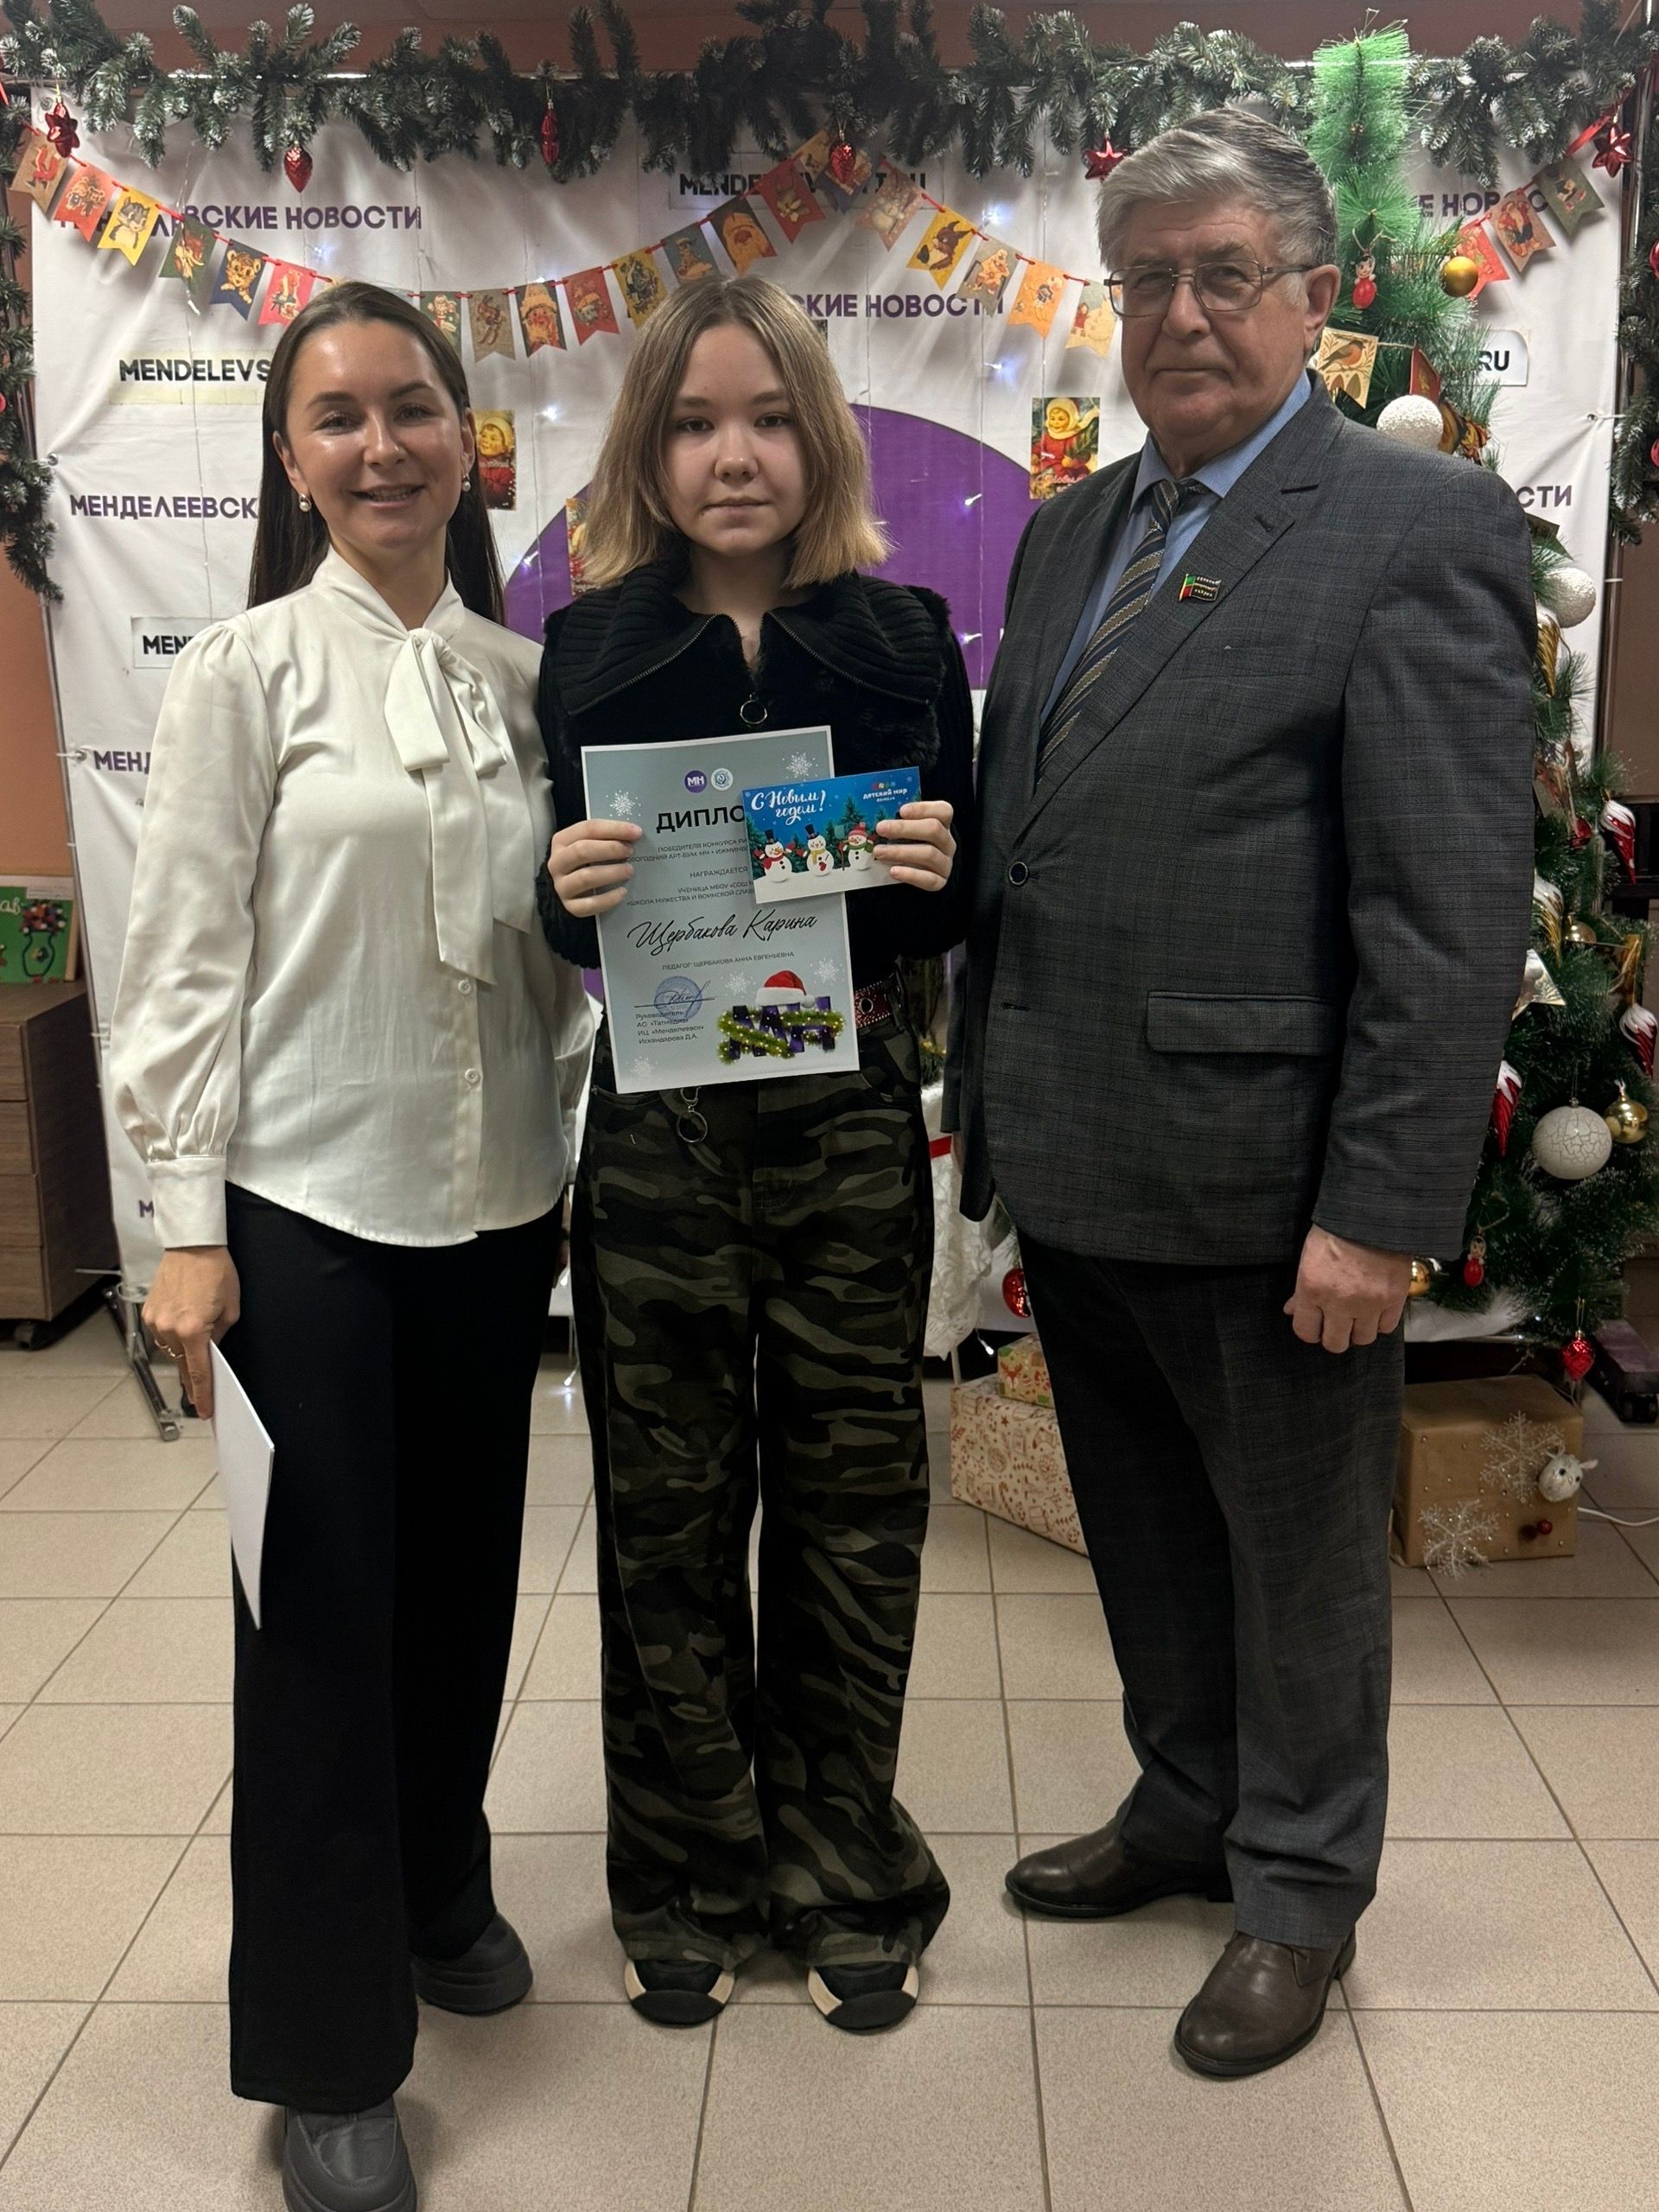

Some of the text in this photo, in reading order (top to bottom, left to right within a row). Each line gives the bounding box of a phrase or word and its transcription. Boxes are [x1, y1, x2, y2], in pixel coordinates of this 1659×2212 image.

[285, 205, 422, 230] НОВОСТИ
[143, 635, 194, 655] MEN
[687, 776, 705, 787] МН
[766, 788, 819, 808] Новым
[626, 854, 668, 862] ОВОГОДНИЙ
[690, 866, 749, 879] НАГРАЖДАЕТСЯ
[627, 908, 817, 957] Щербакова Карина
